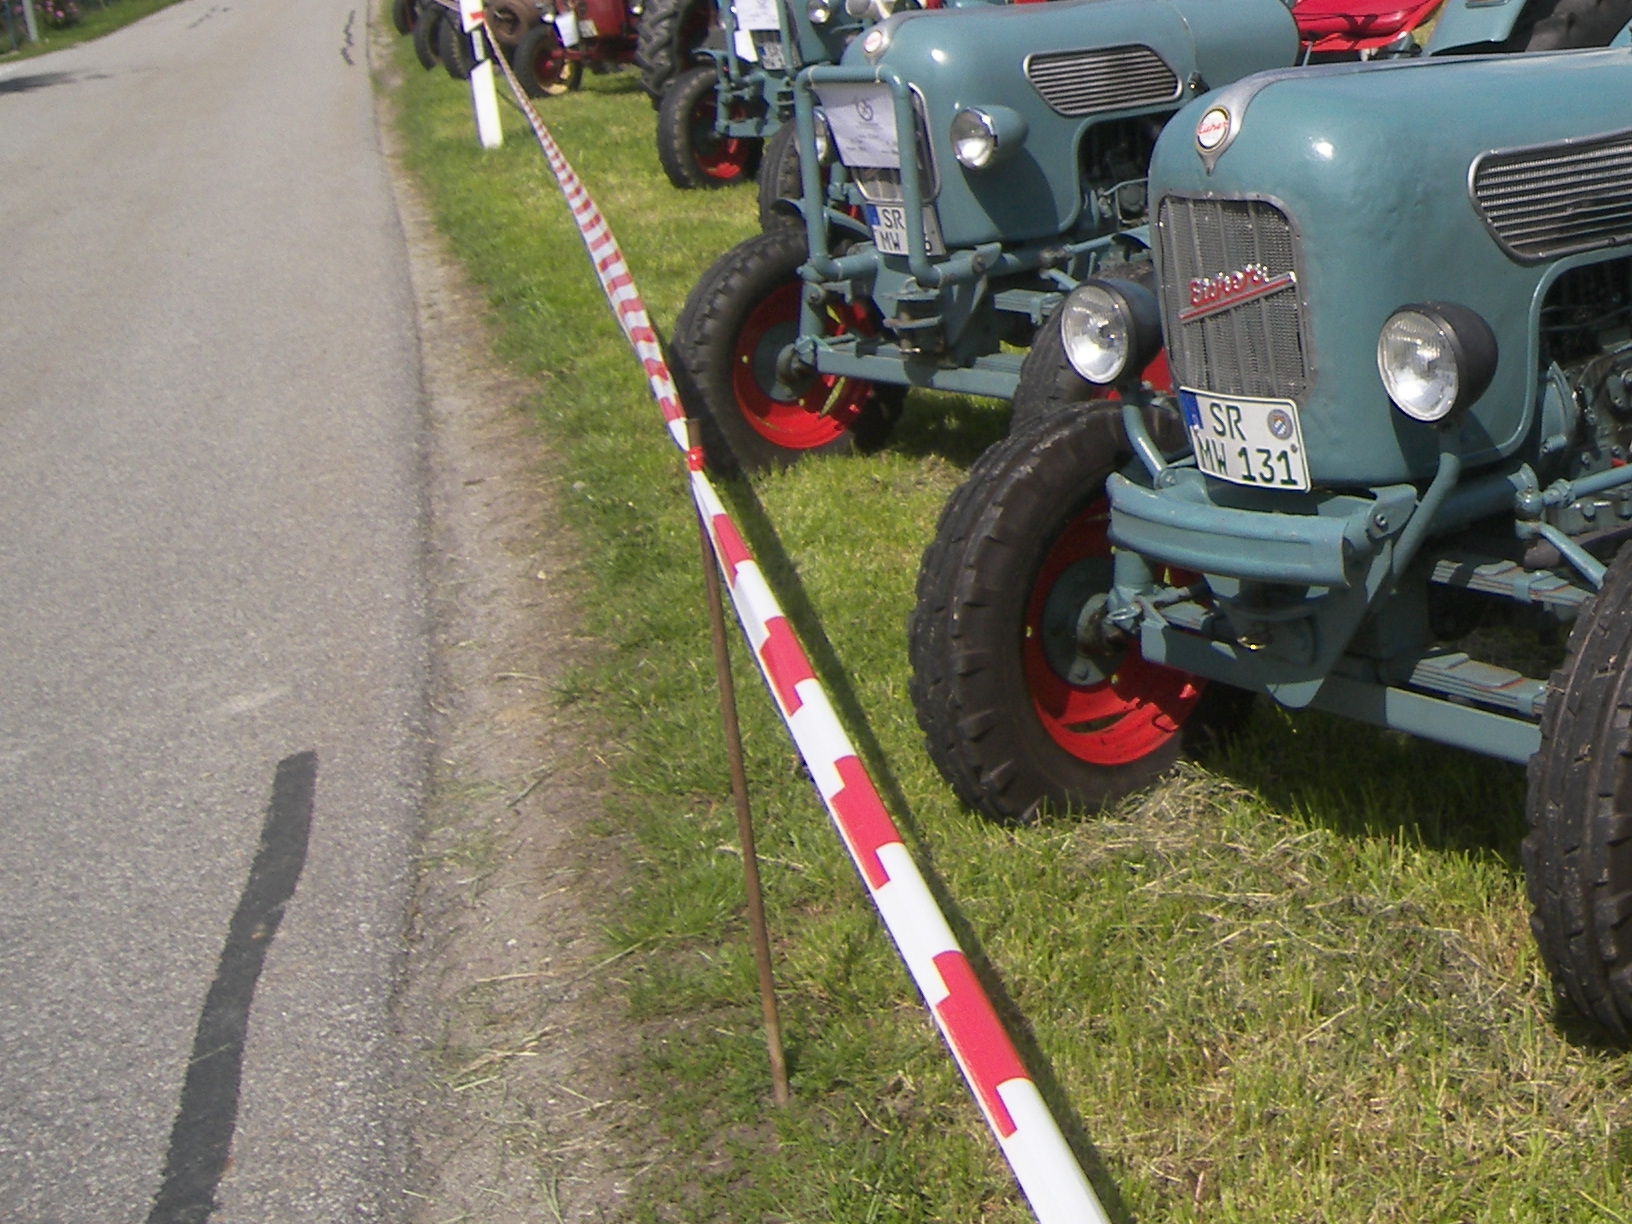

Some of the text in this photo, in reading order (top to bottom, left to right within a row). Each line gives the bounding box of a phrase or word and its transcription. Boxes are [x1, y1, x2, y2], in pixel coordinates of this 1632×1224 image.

[881, 208, 905, 229] SR
[879, 230, 901, 252] MW
[1209, 402, 1247, 441] SR
[1196, 432, 1298, 486] MW 131
